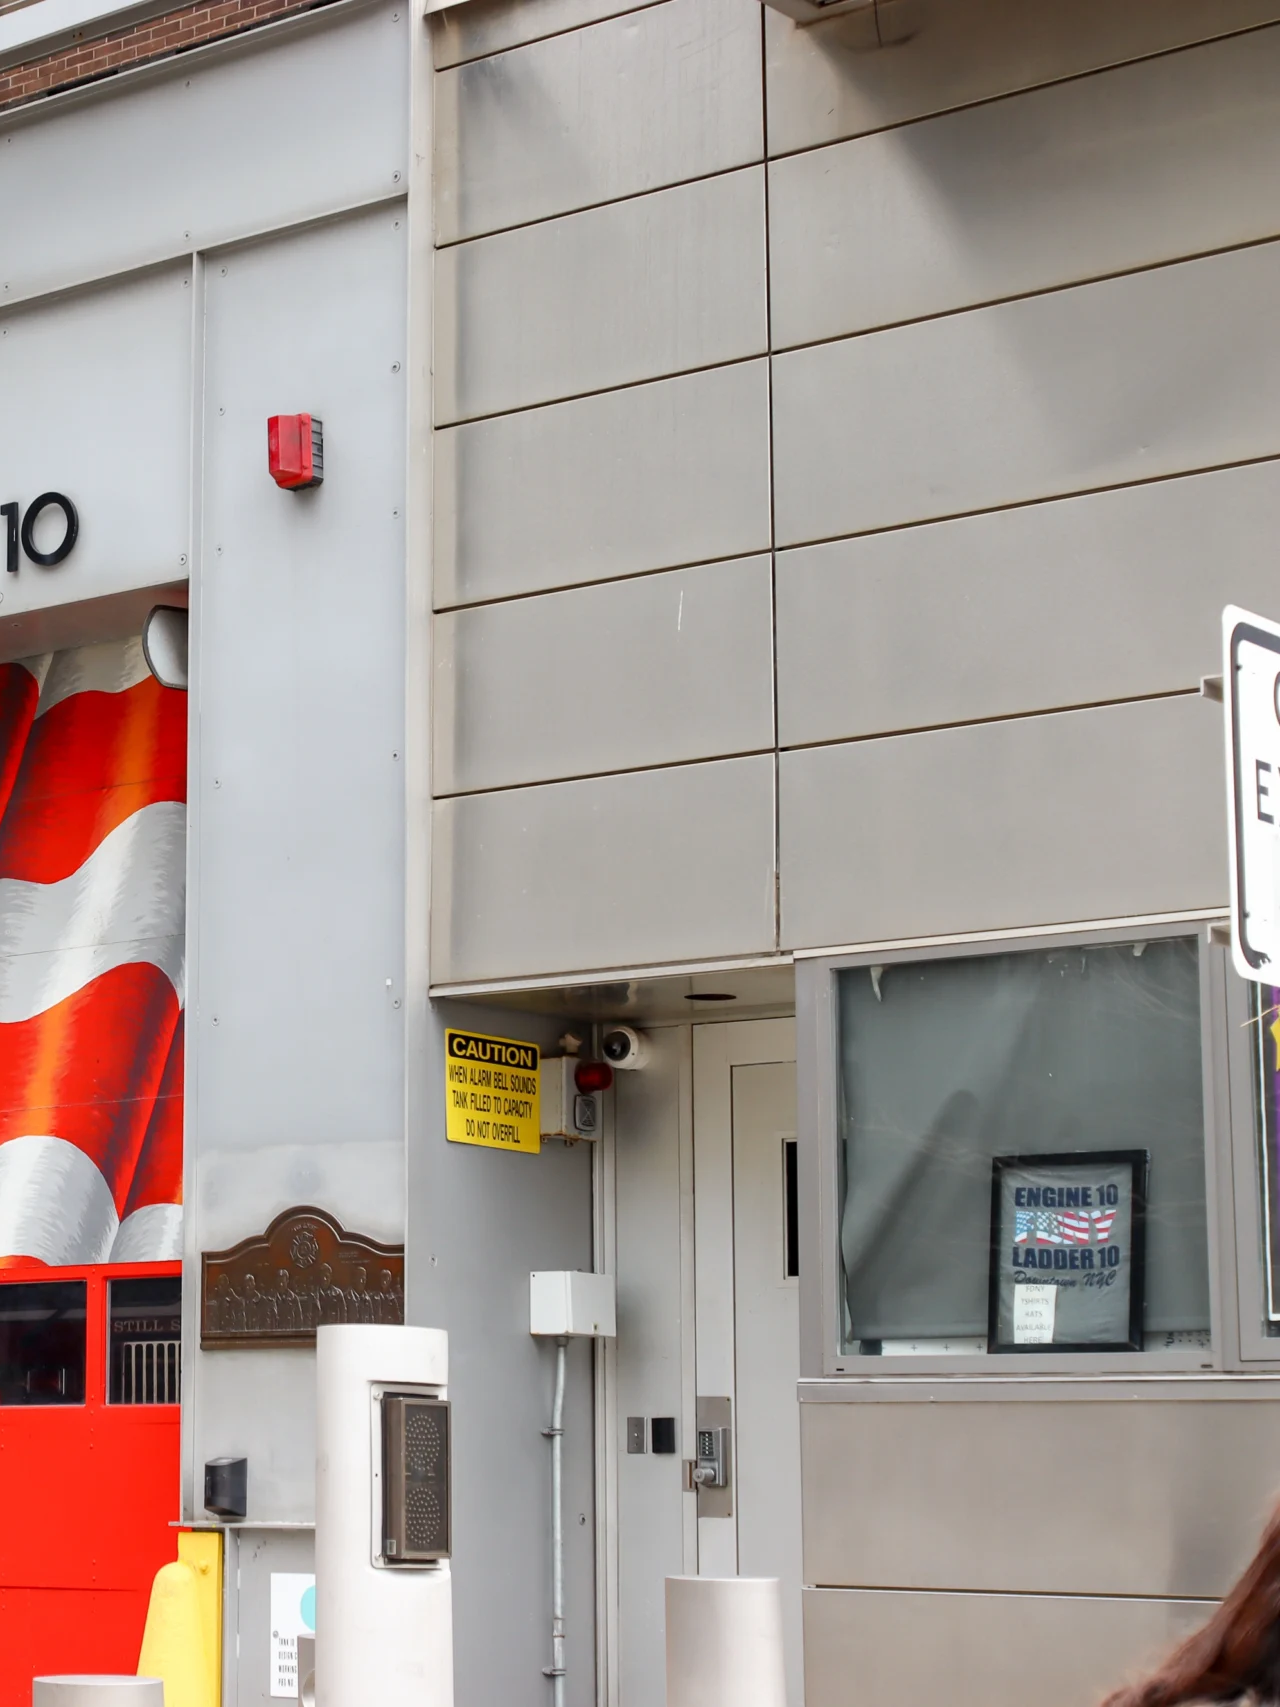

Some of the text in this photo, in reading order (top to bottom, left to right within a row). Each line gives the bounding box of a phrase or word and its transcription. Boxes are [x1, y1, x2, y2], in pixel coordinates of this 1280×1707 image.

[0, 491, 79, 573] 10
[453, 1037, 532, 1067] CAUTION
[449, 1064, 537, 1095] WHEN ALARM BELL SOUNDS
[452, 1090, 533, 1119] TANK FILLED TO CAPACITY
[466, 1118, 520, 1143] DO NOT OVERFILL
[1014, 1184, 1118, 1208] ENGINE 10
[1015, 1209, 1117, 1244] FDNY
[1012, 1245, 1120, 1270] LADDER 10
[1083, 1269, 1116, 1289] NYC
[114, 1320, 163, 1333] STILL
